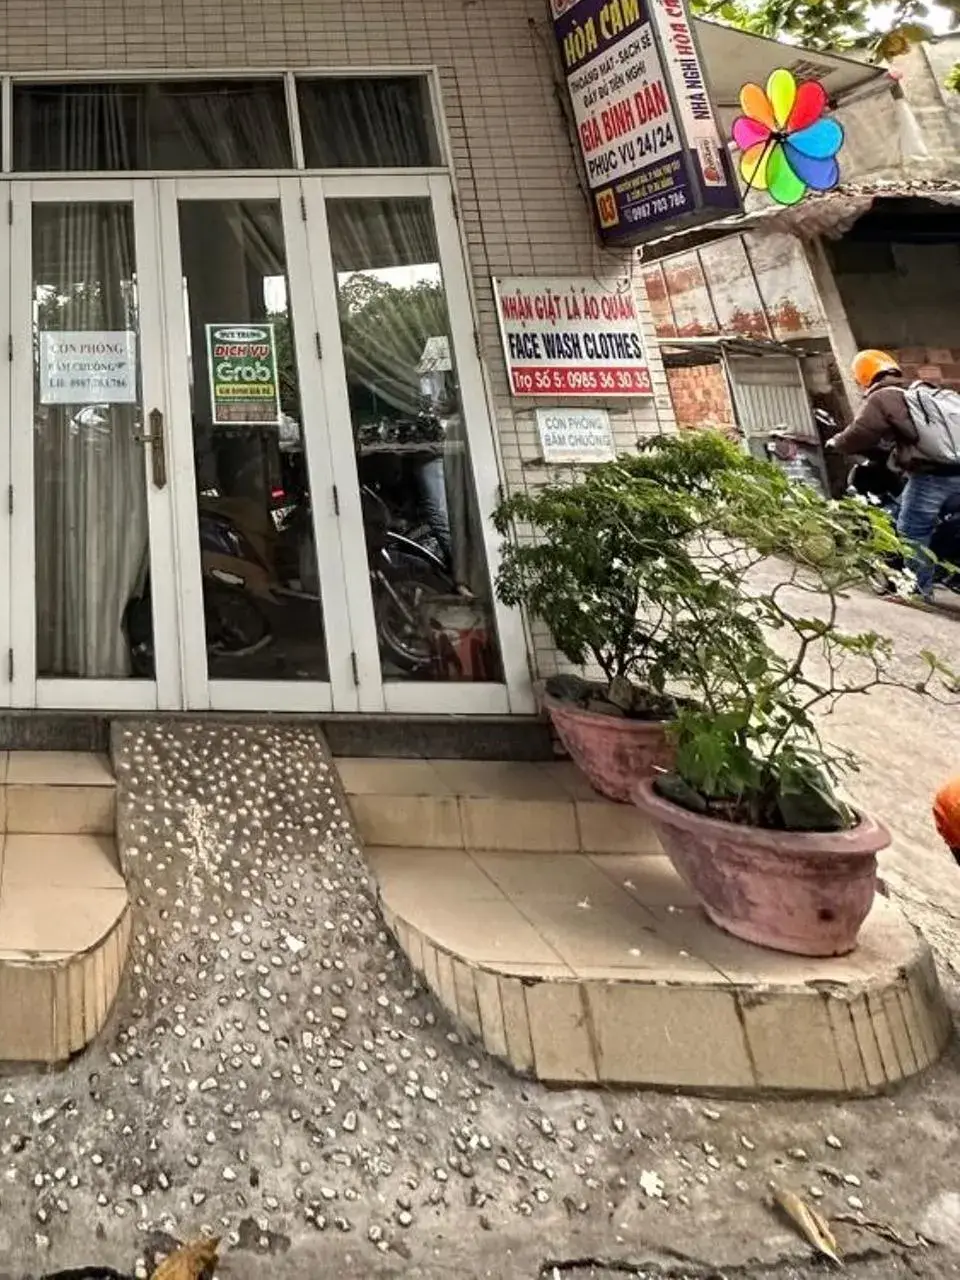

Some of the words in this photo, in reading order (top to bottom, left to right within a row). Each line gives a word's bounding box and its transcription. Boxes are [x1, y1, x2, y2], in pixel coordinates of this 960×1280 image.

[564, 20, 598, 66] HÒA
[675, 58, 701, 93] NGHỈ
[580, 109, 602, 152] GIÁ
[602, 99, 637, 141] BÌNH
[639, 80, 668, 125] DÂN
[689, 93, 710, 120] NHÀ
[589, 151, 618, 179] PHỤC
[618, 143, 635, 168] VỤ
[639, 123, 675, 157] 24/24
[501, 289, 533, 328] NHẬN
[534, 288, 561, 326] GIẶT
[565, 286, 581, 320] LÀ
[582, 287, 600, 320] ÁO
[508, 332, 541, 359] FACE
[541, 333, 585, 360] WASH
[584, 333, 642, 360] CLOTHES
[216, 360, 272, 381] Grab
[536, 370, 551, 389] Số
[567, 371, 597, 389] 0985
[599, 371, 615, 389] 36
[617, 371, 633, 389] 30
[634, 371, 650, 389] 35
